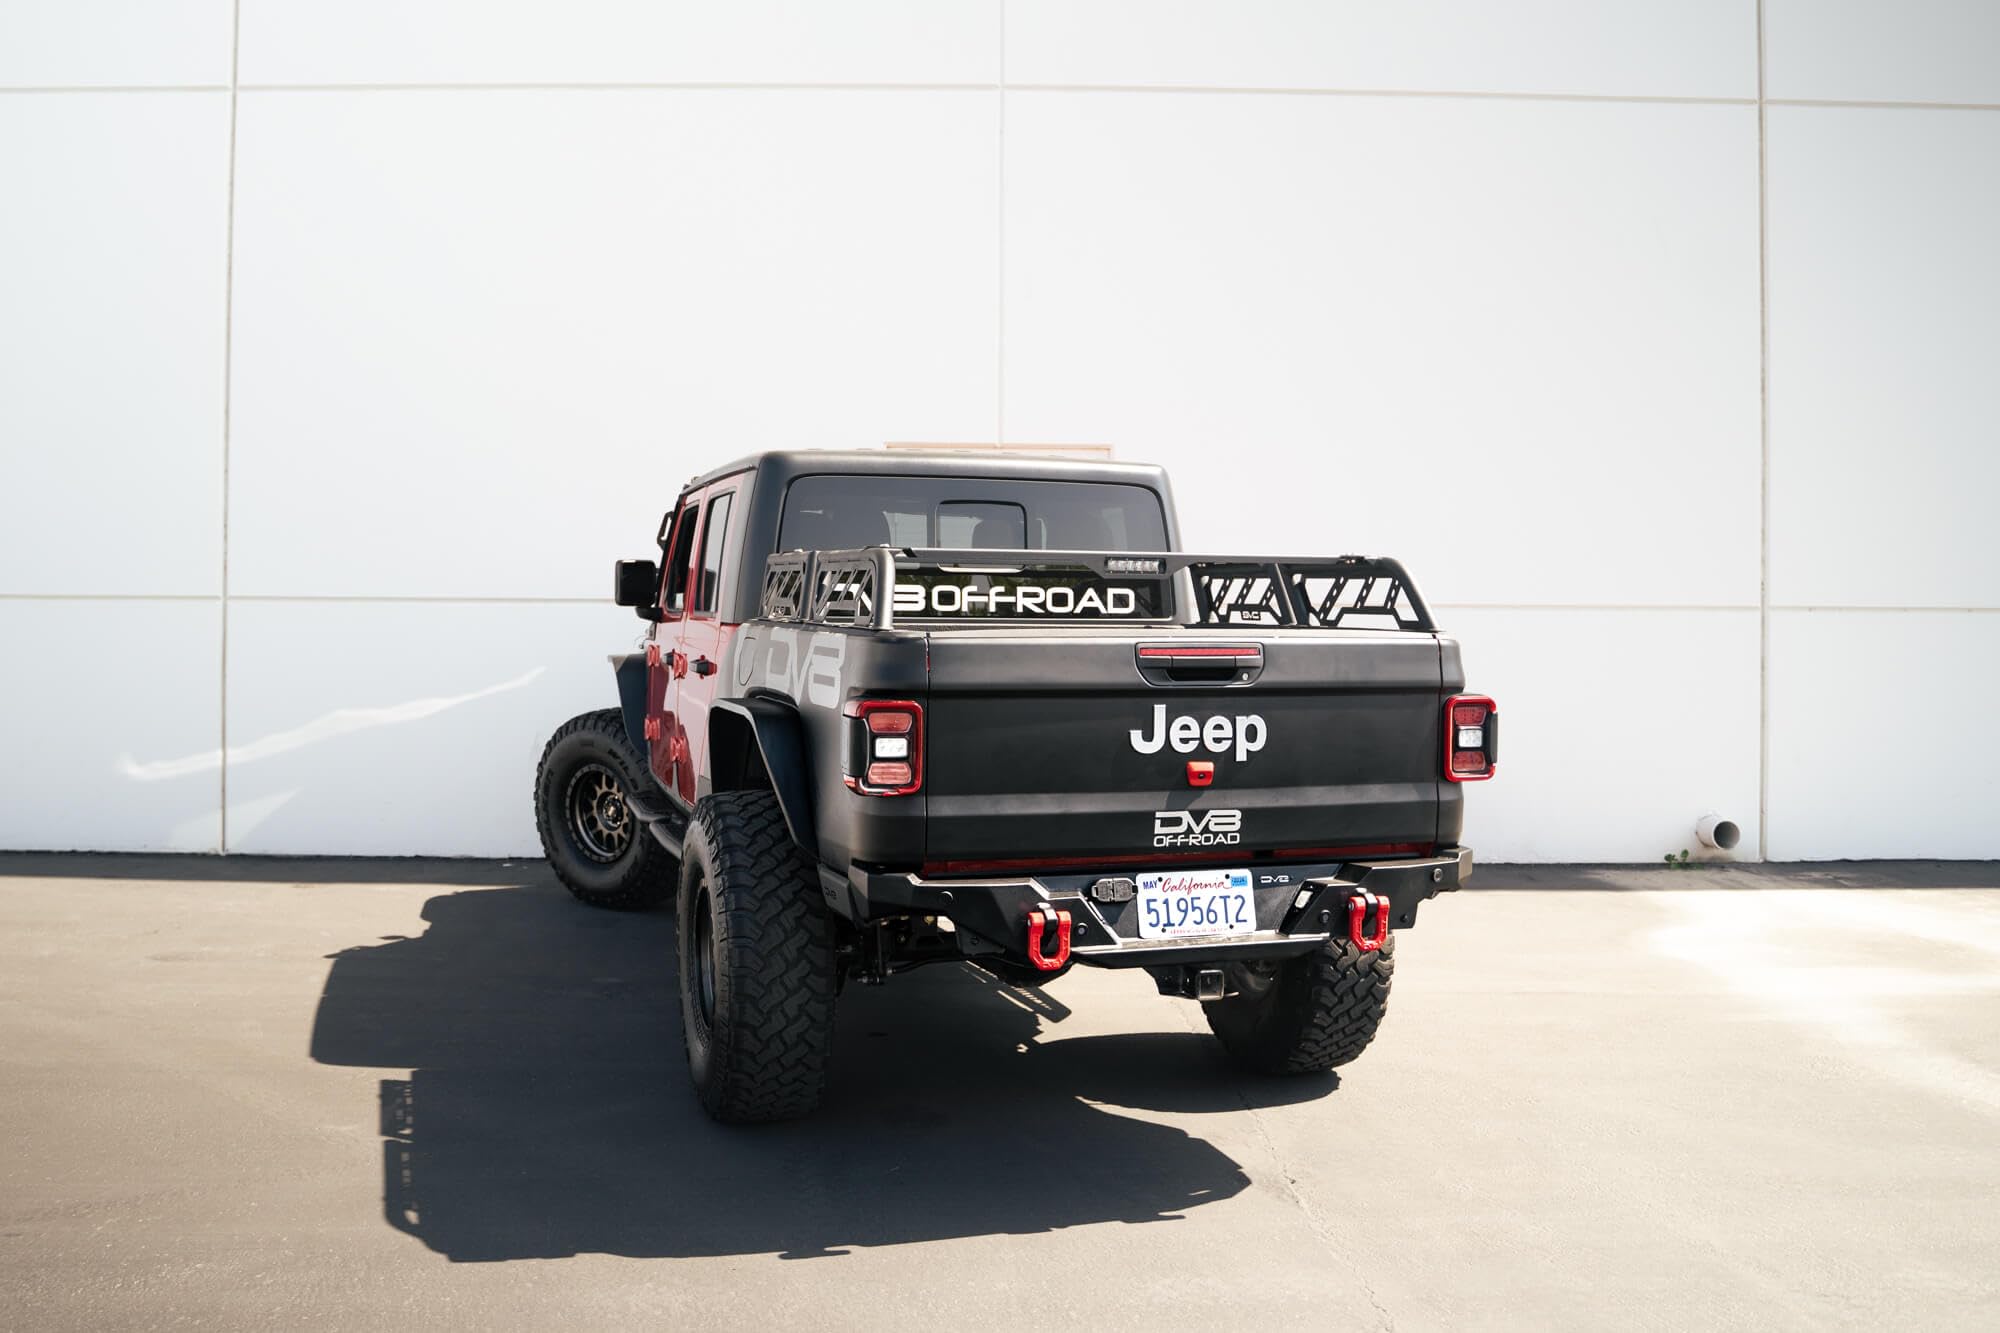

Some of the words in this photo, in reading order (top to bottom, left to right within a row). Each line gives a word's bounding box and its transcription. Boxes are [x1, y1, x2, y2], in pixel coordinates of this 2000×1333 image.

[931, 585, 1135, 614] OFFROAD
[765, 626, 847, 709] DV8
[1129, 704, 1267, 761] Jeep
[1154, 809, 1242, 834] DV8
[1153, 832, 1241, 847] OFFROAD
[1143, 880, 1158, 889] MAY
[1162, 877, 1232, 895] California
[1146, 895, 1248, 928] 51956T2
